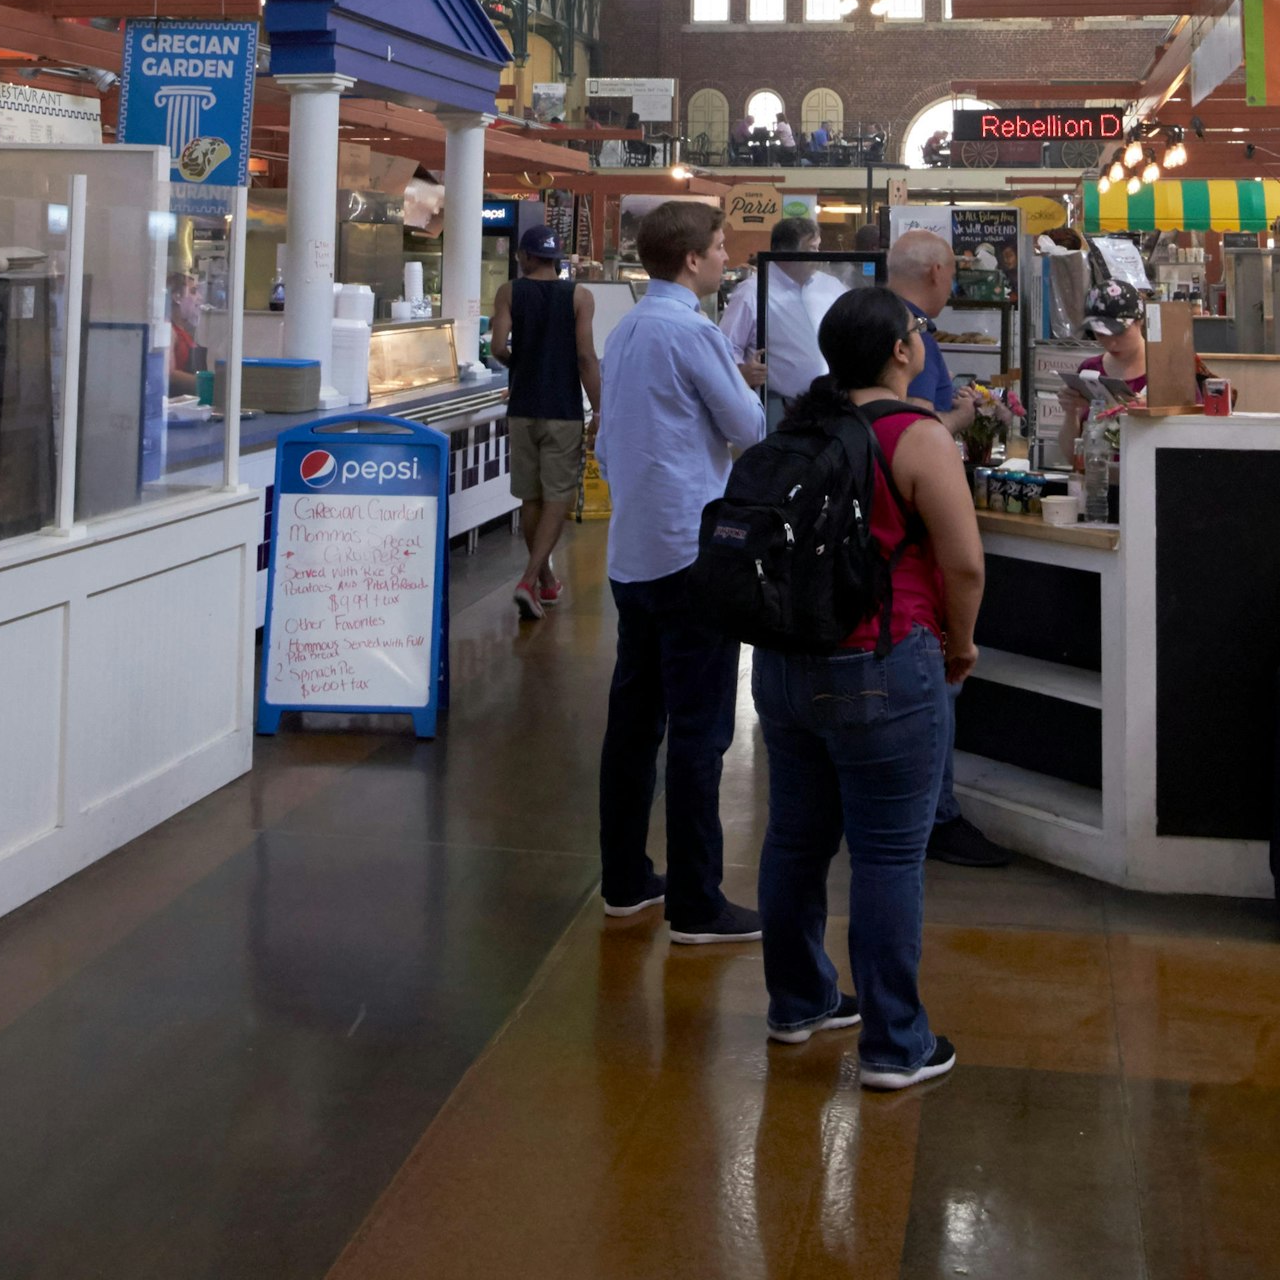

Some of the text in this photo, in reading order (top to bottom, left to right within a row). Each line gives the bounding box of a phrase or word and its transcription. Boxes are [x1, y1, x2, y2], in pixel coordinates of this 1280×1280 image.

[140, 33, 240, 55] GRECIAN
[141, 57, 235, 79] GARDEN
[982, 114, 1120, 138] Rebellion D
[729, 196, 779, 216] Paris
[342, 457, 419, 484] pepsi
[285, 614, 386, 634] Other Favorites
